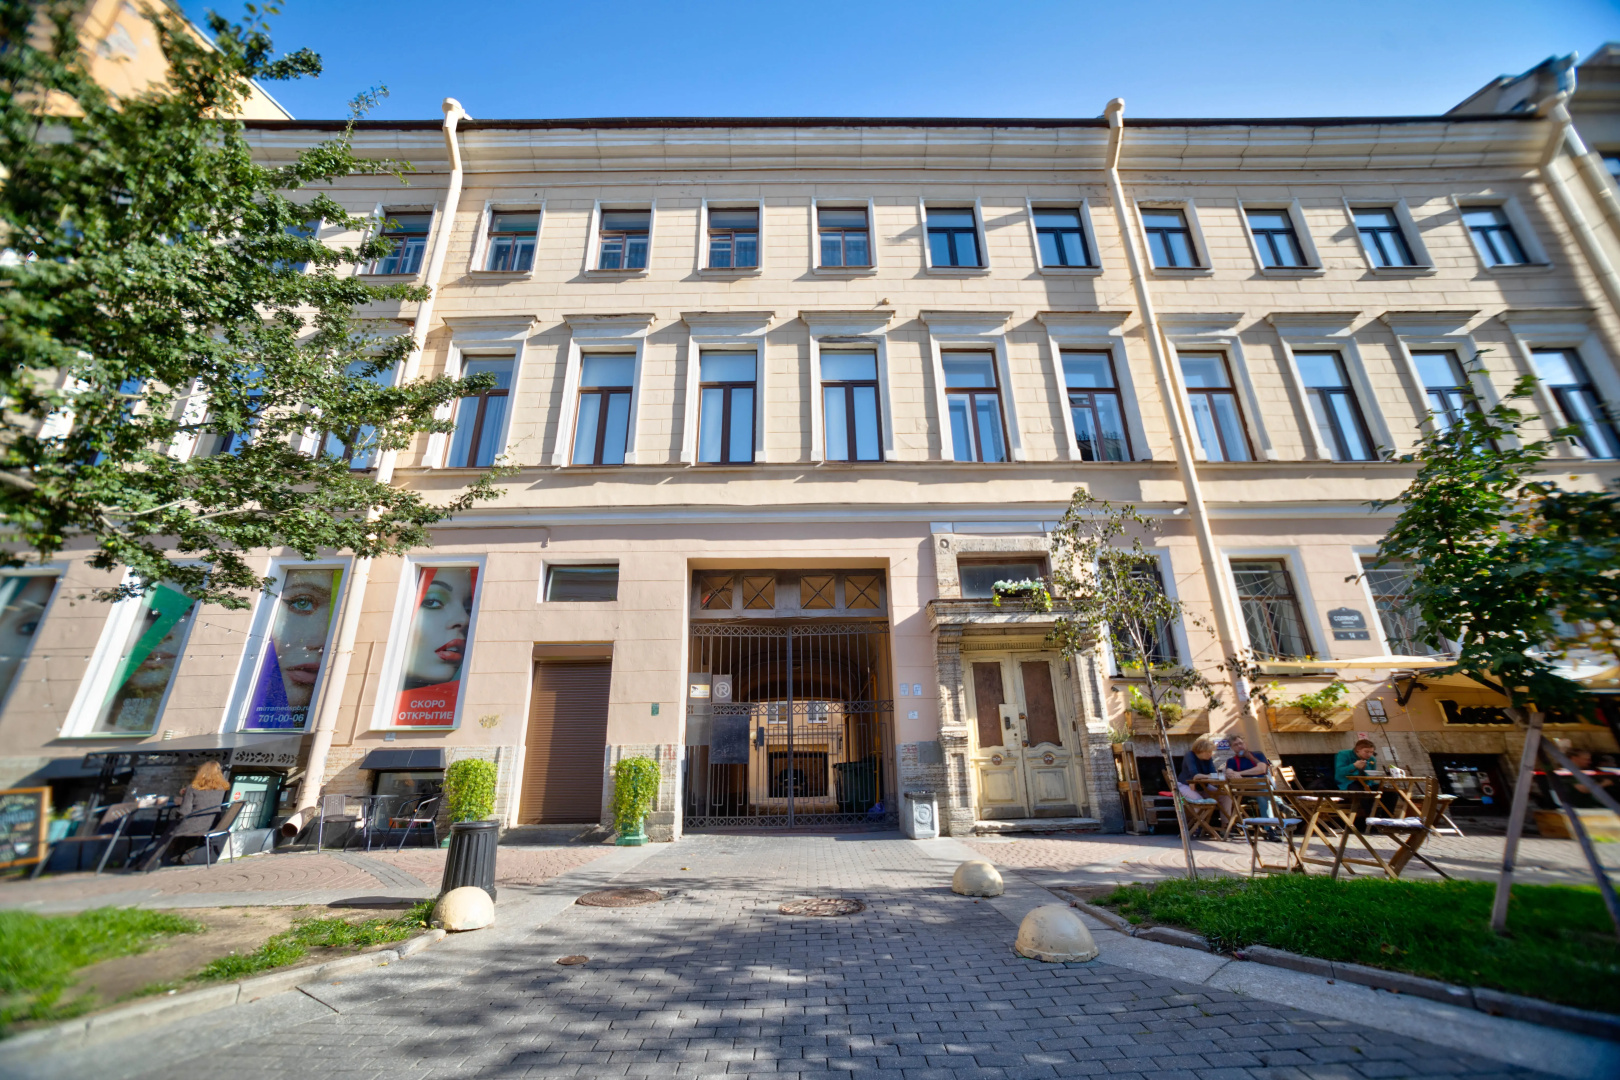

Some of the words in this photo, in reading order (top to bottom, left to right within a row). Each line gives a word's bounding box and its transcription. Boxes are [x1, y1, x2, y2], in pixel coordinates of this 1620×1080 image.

[410, 699, 446, 708] СКОРО
[258, 713, 305, 723] 701-00-06
[398, 711, 453, 720] ОТКРЫТИЕ
